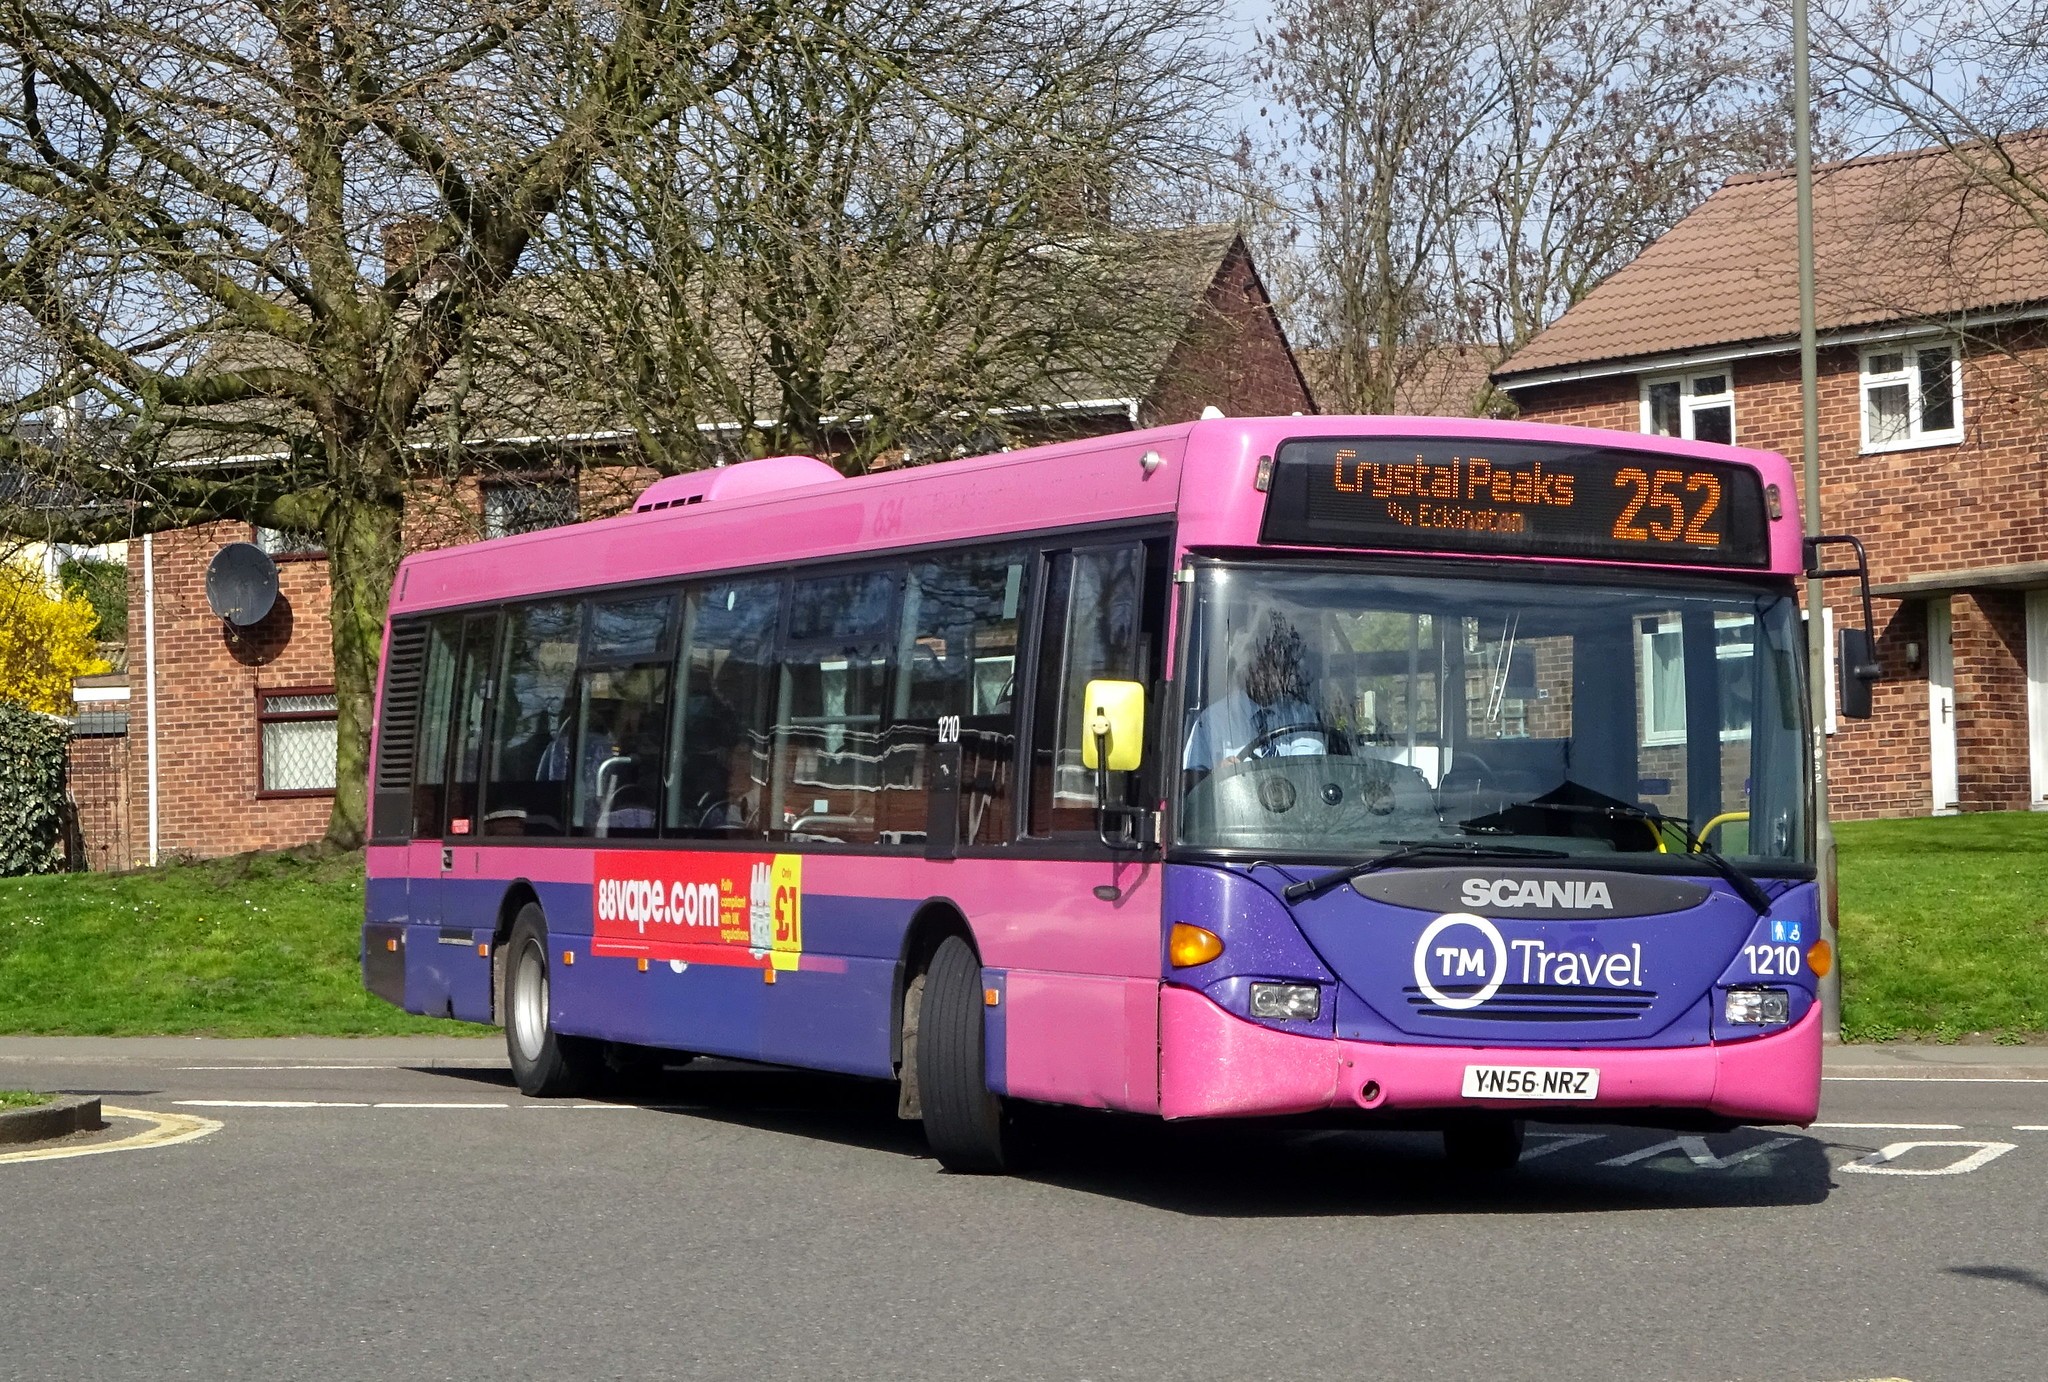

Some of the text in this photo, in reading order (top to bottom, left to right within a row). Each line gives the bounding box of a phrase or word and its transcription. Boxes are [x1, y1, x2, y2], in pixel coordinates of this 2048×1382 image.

[1335, 449, 1574, 505] Crystal Peaks
[1613, 468, 1721, 544] 252
[937, 715, 960, 743] 1210
[598, 879, 719, 933] 88vape.com
[775, 885, 798, 943] £1
[1461, 879, 1613, 909] SCANIA
[1435, 940, 1643, 987] TM Travel
[1744, 945, 1800, 976] 1210
[1476, 1070, 1589, 1094] YN56 NRZ
